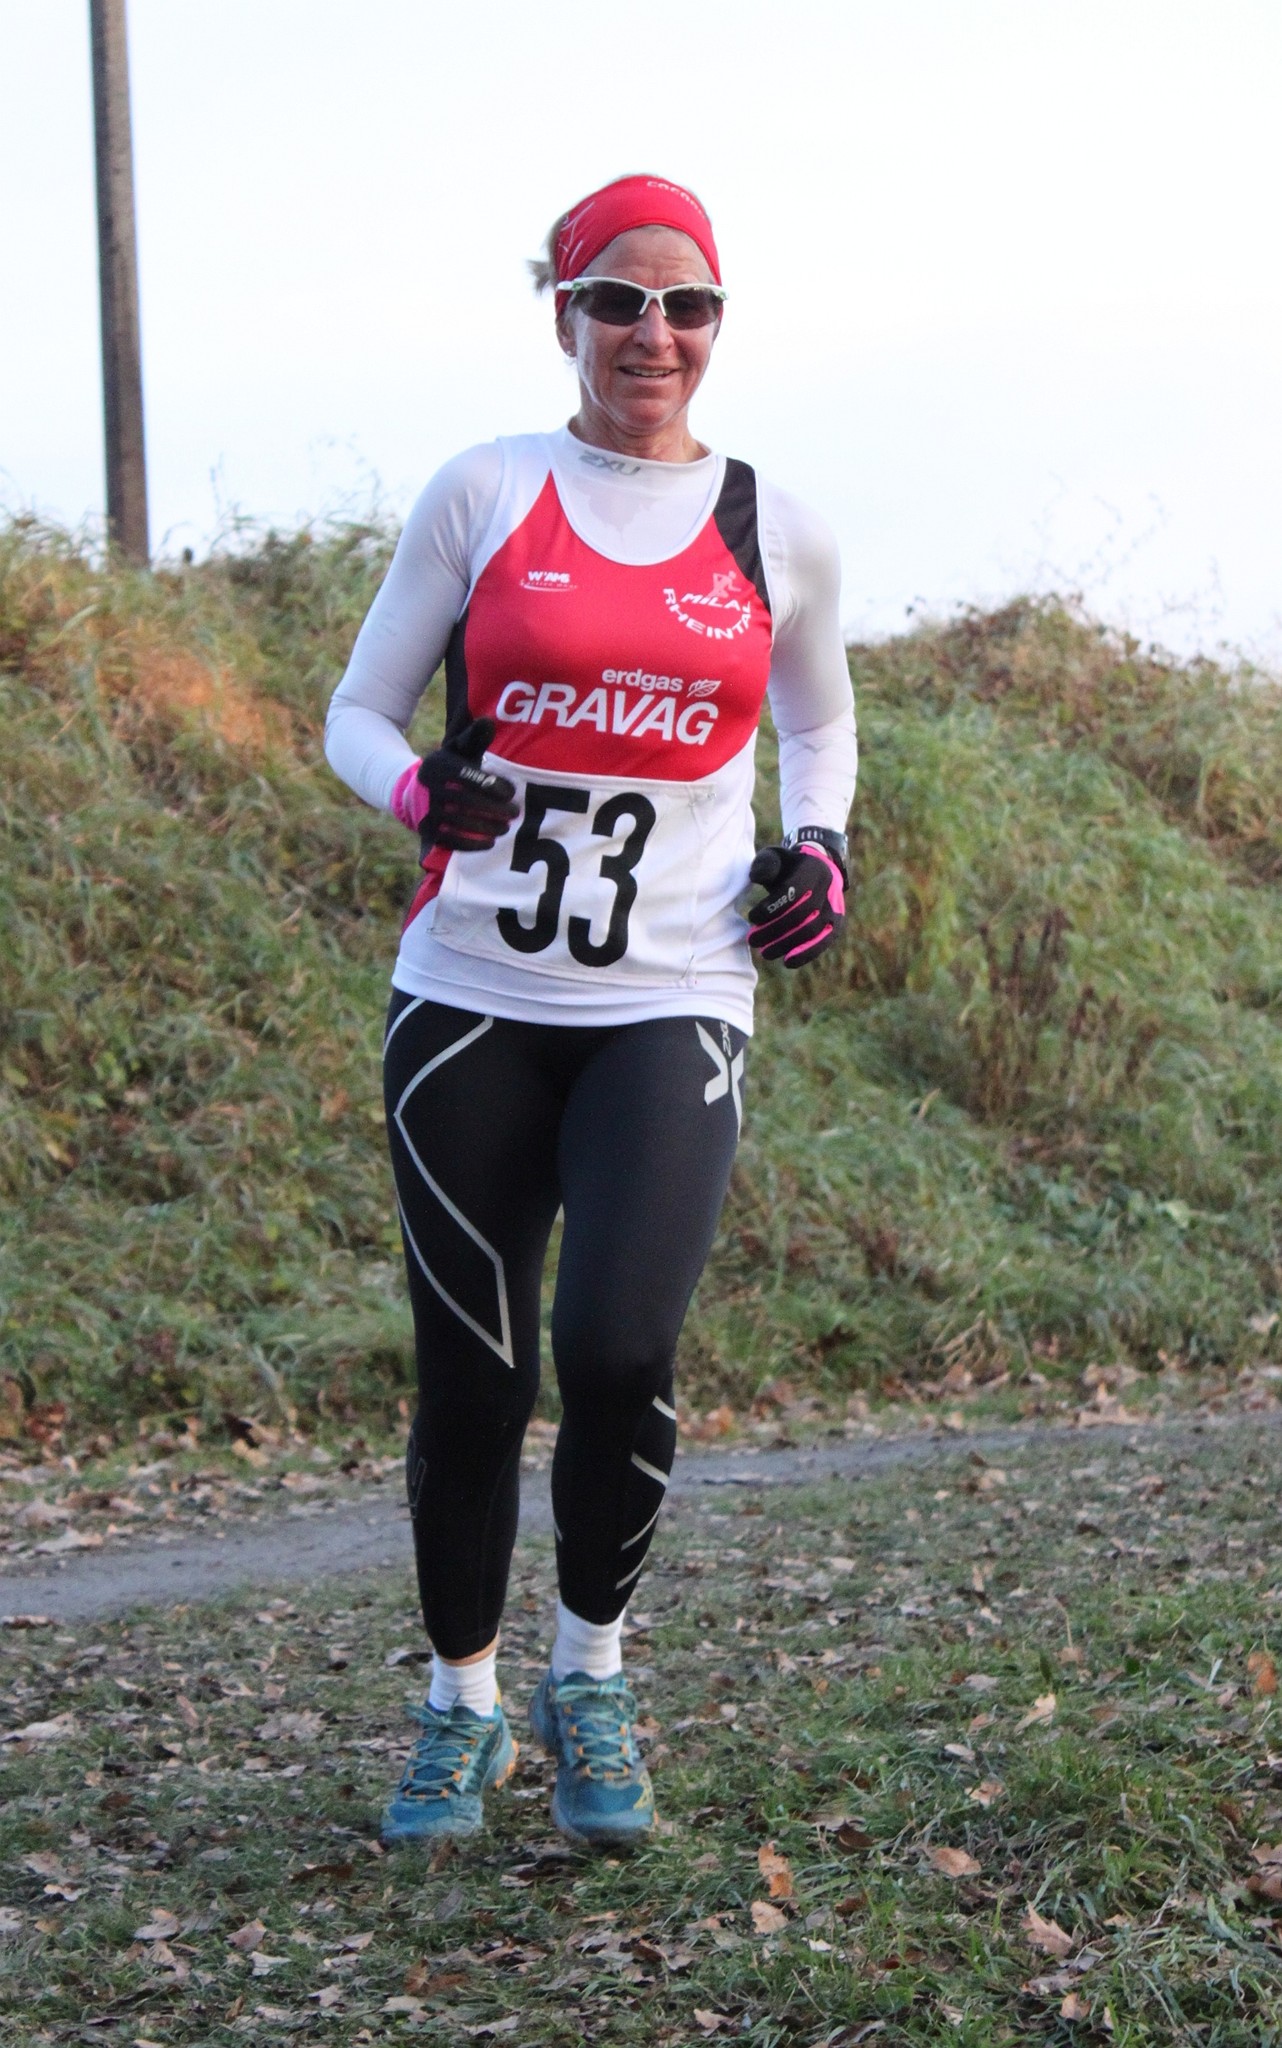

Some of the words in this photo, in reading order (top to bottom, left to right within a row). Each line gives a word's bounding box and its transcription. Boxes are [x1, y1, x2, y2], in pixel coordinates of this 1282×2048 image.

[578, 450, 641, 476] 2XU
[663, 588, 751, 639] RHEINTAL
[681, 593, 741, 611] MILA
[602, 668, 684, 692] erdgas
[496, 680, 719, 745] GRAVAG
[496, 782, 656, 967] 53
